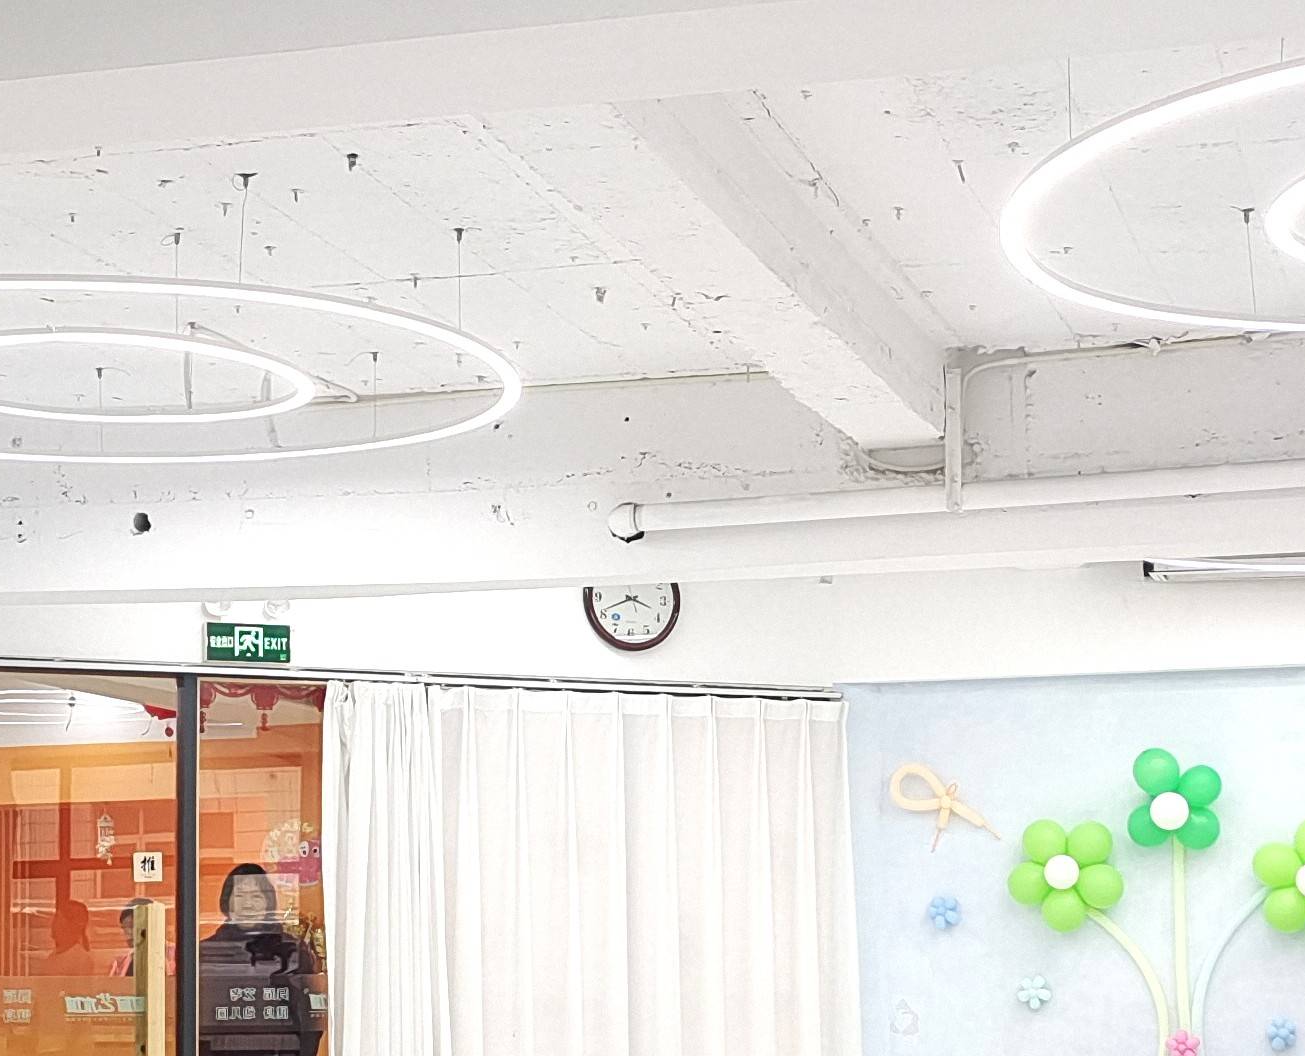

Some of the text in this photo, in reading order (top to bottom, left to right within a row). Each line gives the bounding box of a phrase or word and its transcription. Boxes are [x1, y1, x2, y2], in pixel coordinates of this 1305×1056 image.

[595, 592, 603, 602] 9
[660, 596, 667, 606] 3
[600, 609, 608, 619] 8
[612, 623, 619, 633] 7
[643, 625, 650, 635] 5
[264, 637, 288, 650] EXIT
[140, 856, 157, 873] 推
